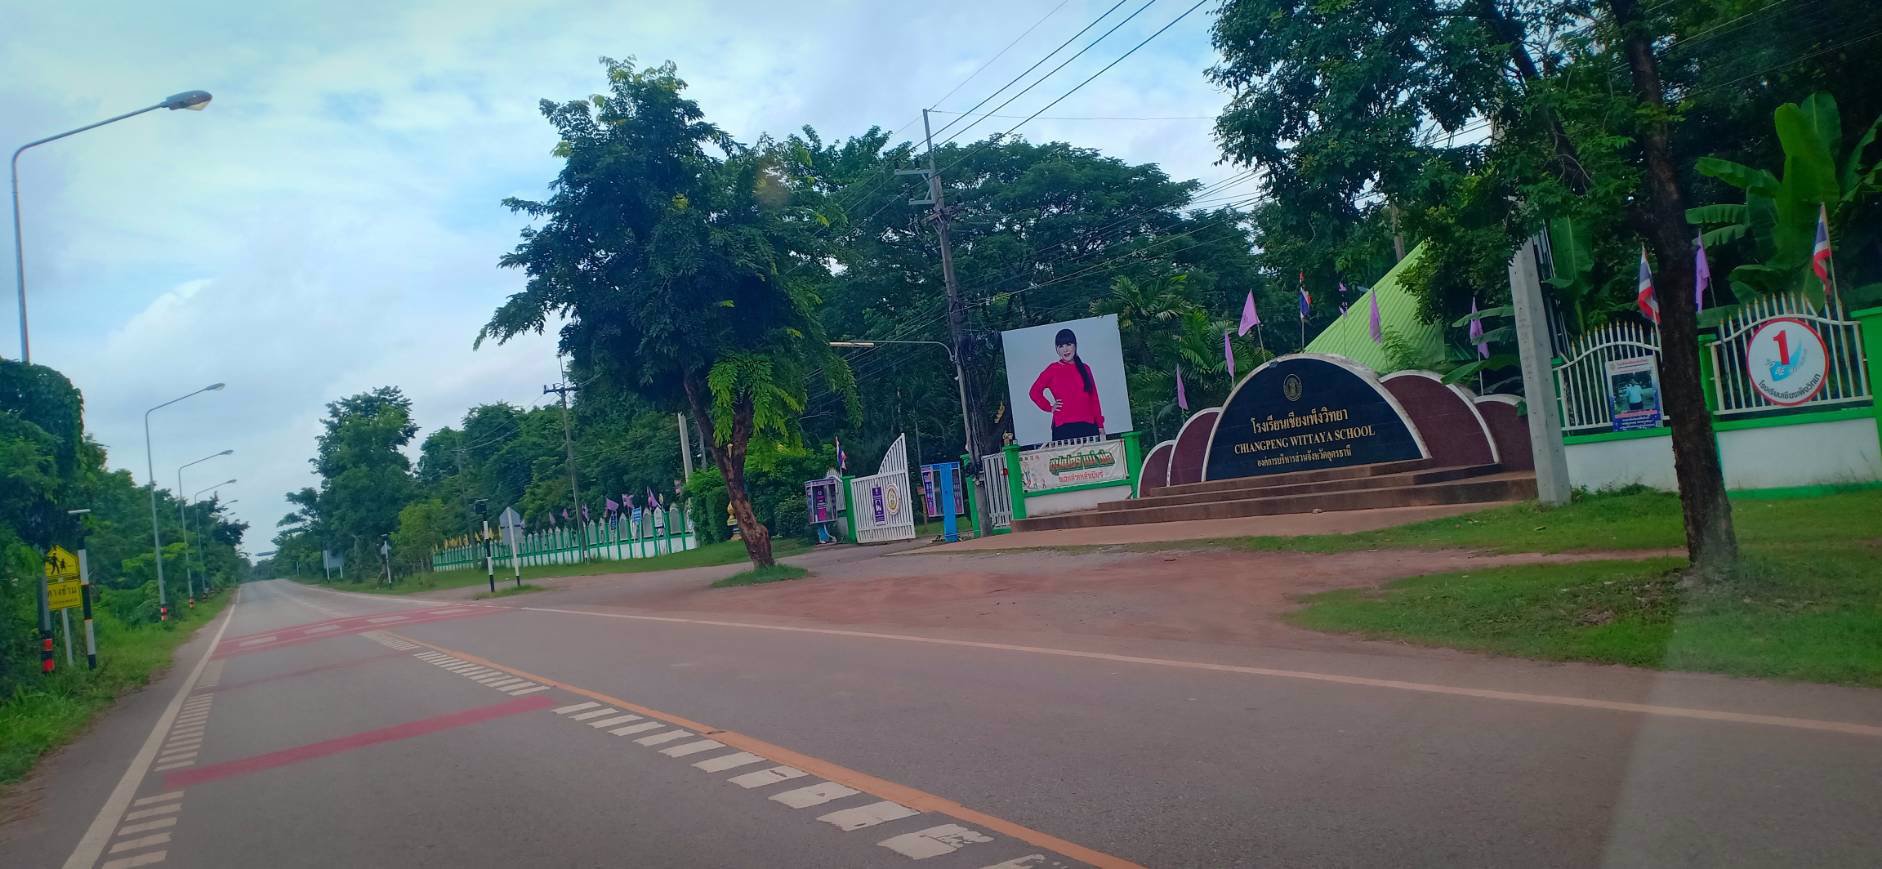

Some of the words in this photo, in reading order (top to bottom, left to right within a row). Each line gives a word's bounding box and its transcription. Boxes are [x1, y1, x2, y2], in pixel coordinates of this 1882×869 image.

[1772, 329, 1790, 365] 1
[1250, 406, 1349, 434] โรงเรียนเชียงเพ็งวิทยา
[1234, 437, 1288, 454] CHIANGPENG
[1290, 431, 1333, 446] WITTAYA
[1334, 425, 1375, 441] SCHOOL
